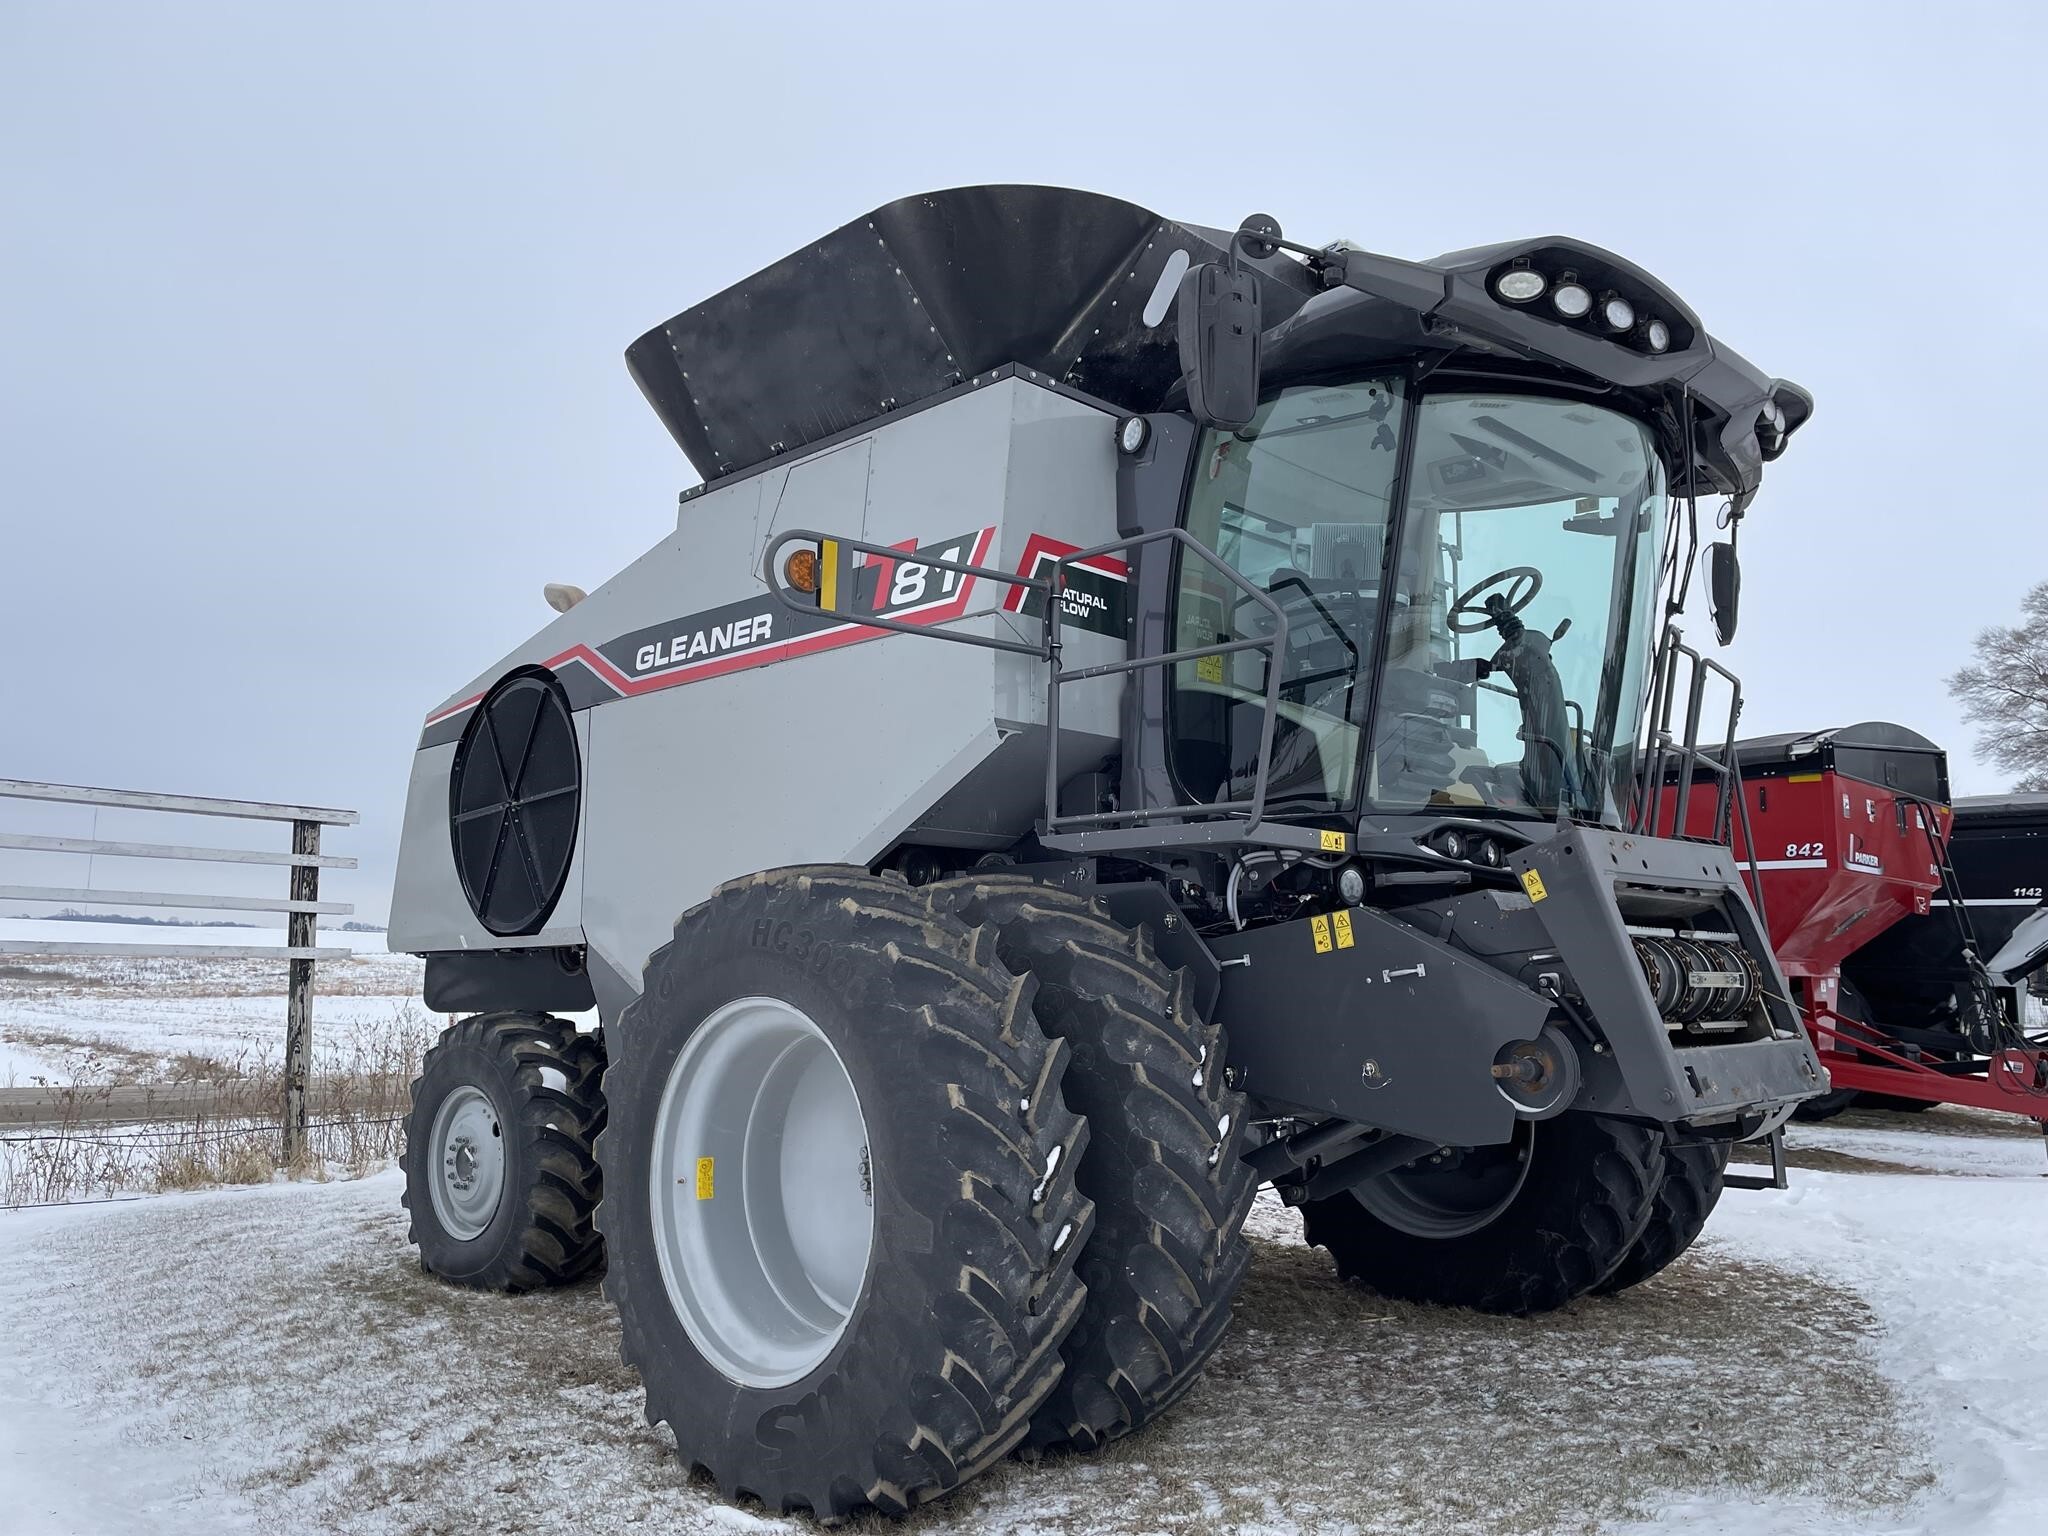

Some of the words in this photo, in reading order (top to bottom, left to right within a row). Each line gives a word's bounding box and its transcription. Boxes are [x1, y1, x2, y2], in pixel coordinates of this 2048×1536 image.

[1062, 588, 1108, 610] ATURAL
[635, 613, 773, 671] GLEANER
[1785, 843, 1824, 858] 842
[1855, 851, 1879, 867] PARKER
[2013, 887, 2043, 897] 1142
